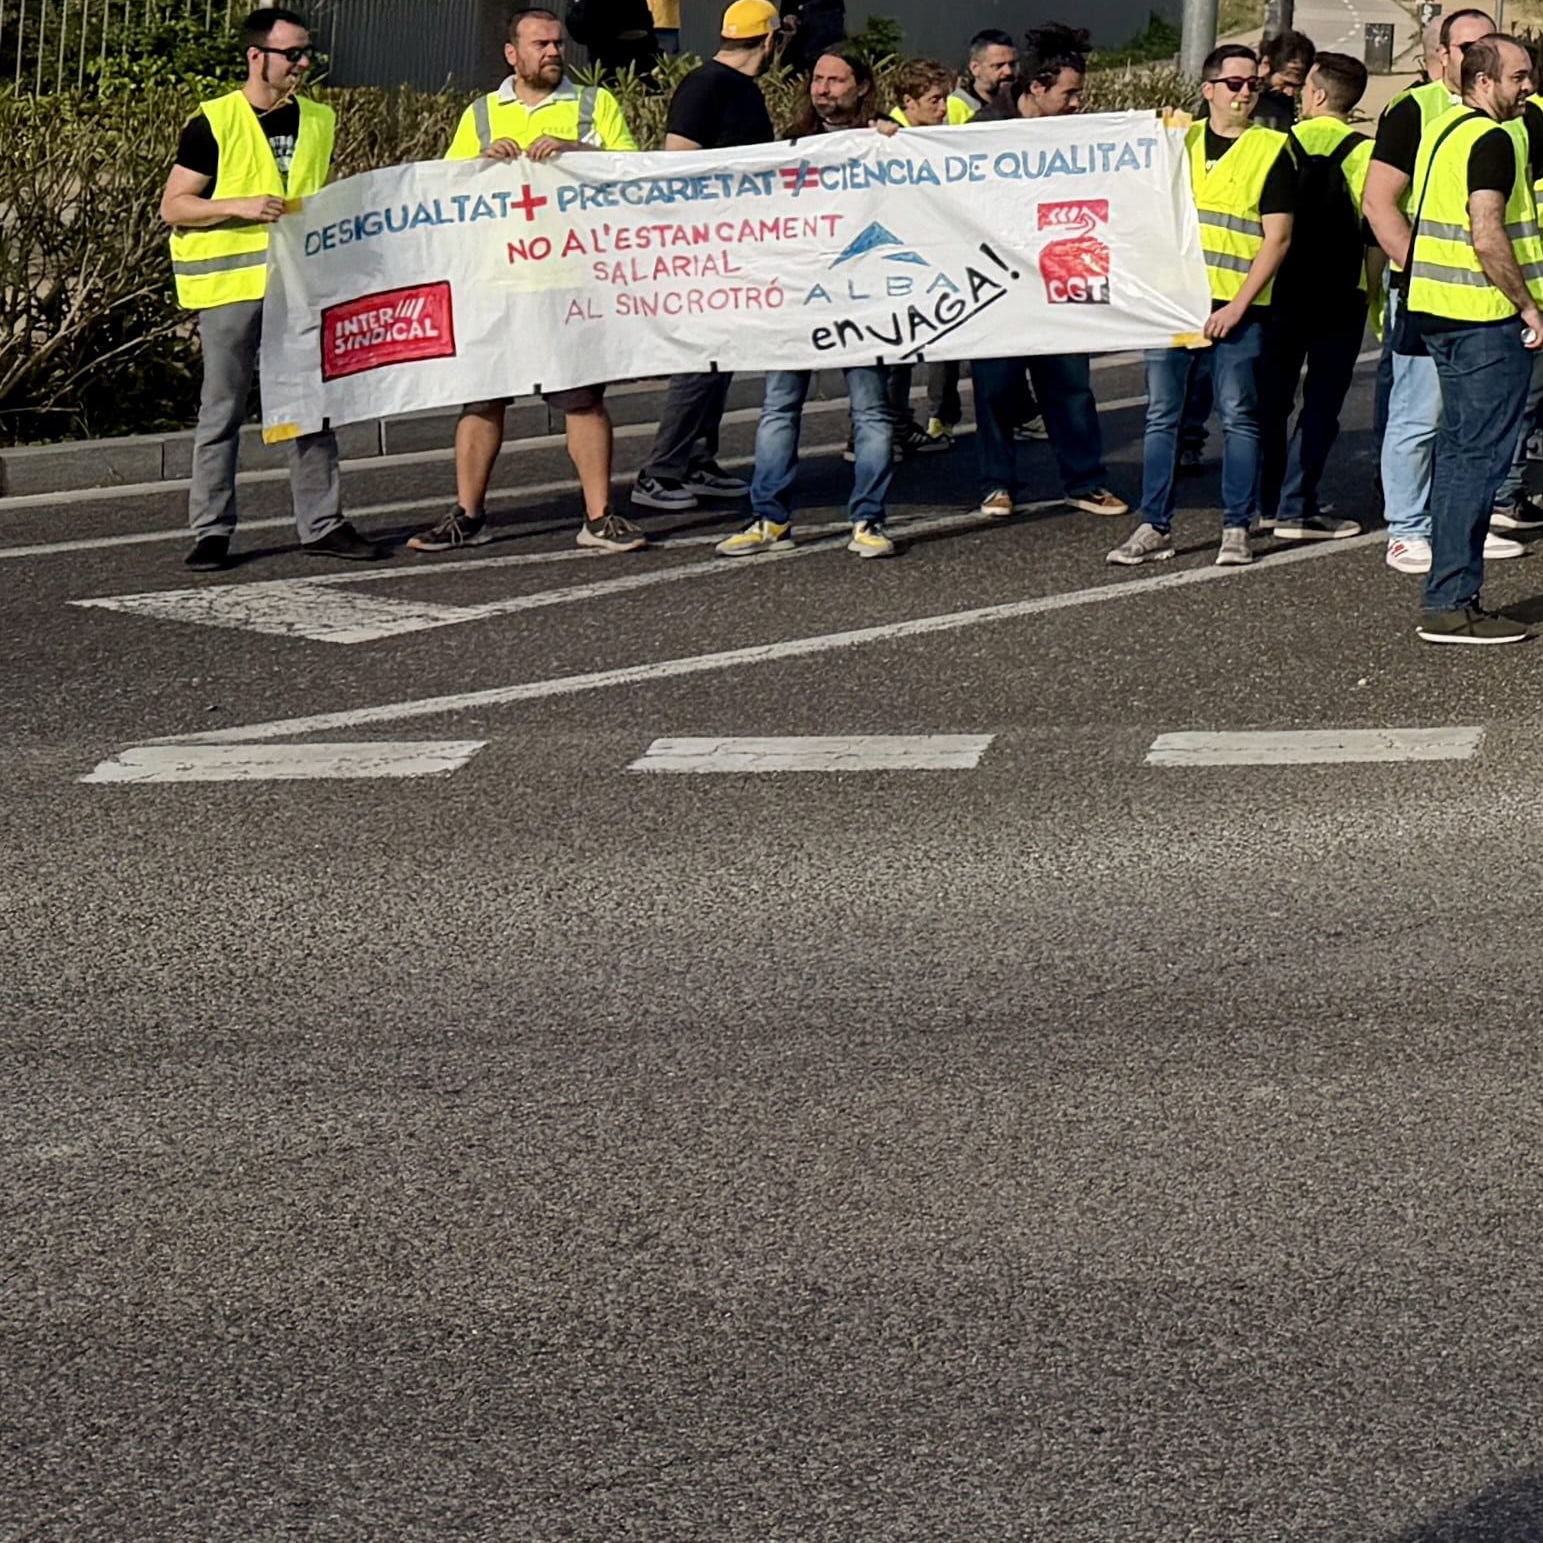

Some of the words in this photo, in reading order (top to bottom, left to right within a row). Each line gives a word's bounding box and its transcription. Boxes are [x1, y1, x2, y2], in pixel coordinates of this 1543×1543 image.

[304, 191, 512, 257] DESIGUALTAT
[556, 170, 778, 212] PRECARIETAT
[818, 156, 941, 191] CIÈNCIA
[945, 153, 989, 183] DE
[993, 138, 1158, 181] QUALITAT
[507, 236, 551, 264] NO
[560, 229, 587, 258] A
[593, 214, 844, 254] L'ESTANCAMENT
[593, 250, 741, 286] SALARIAL
[564, 298, 603, 325] AL
[615, 277, 785, 317] SINCROTRÓ
[803, 271, 961, 306] ALBA
[1048, 276, 1106, 303] CGT
[335, 306, 394, 338] INTER
